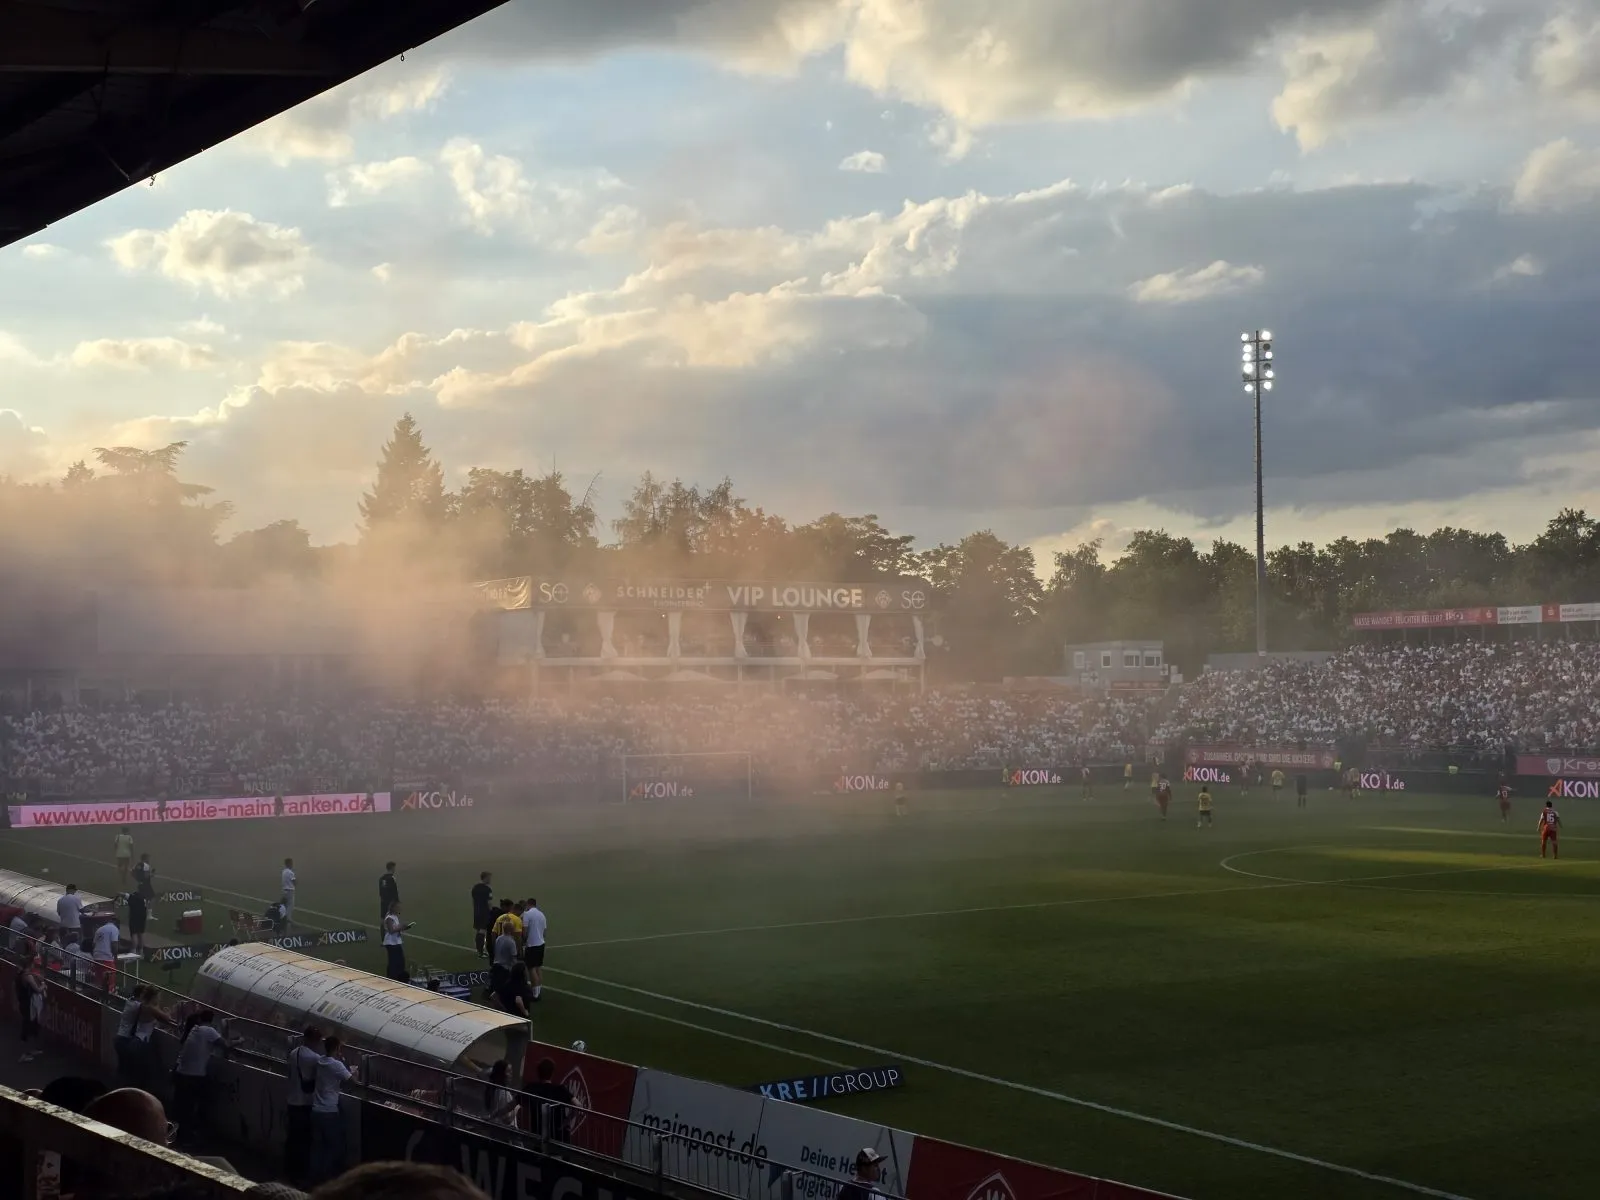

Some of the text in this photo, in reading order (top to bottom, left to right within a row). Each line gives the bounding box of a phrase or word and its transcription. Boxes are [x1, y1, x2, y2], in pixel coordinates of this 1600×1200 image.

[727, 586, 863, 608] VIP LOUNGE
[32, 795, 370, 825] www.wohnmobile-mainranken.de
[457, 971, 489, 987] GRO
[642, 1112, 768, 1169] mainpost.de
[801, 1145, 887, 1185] Deine Het
